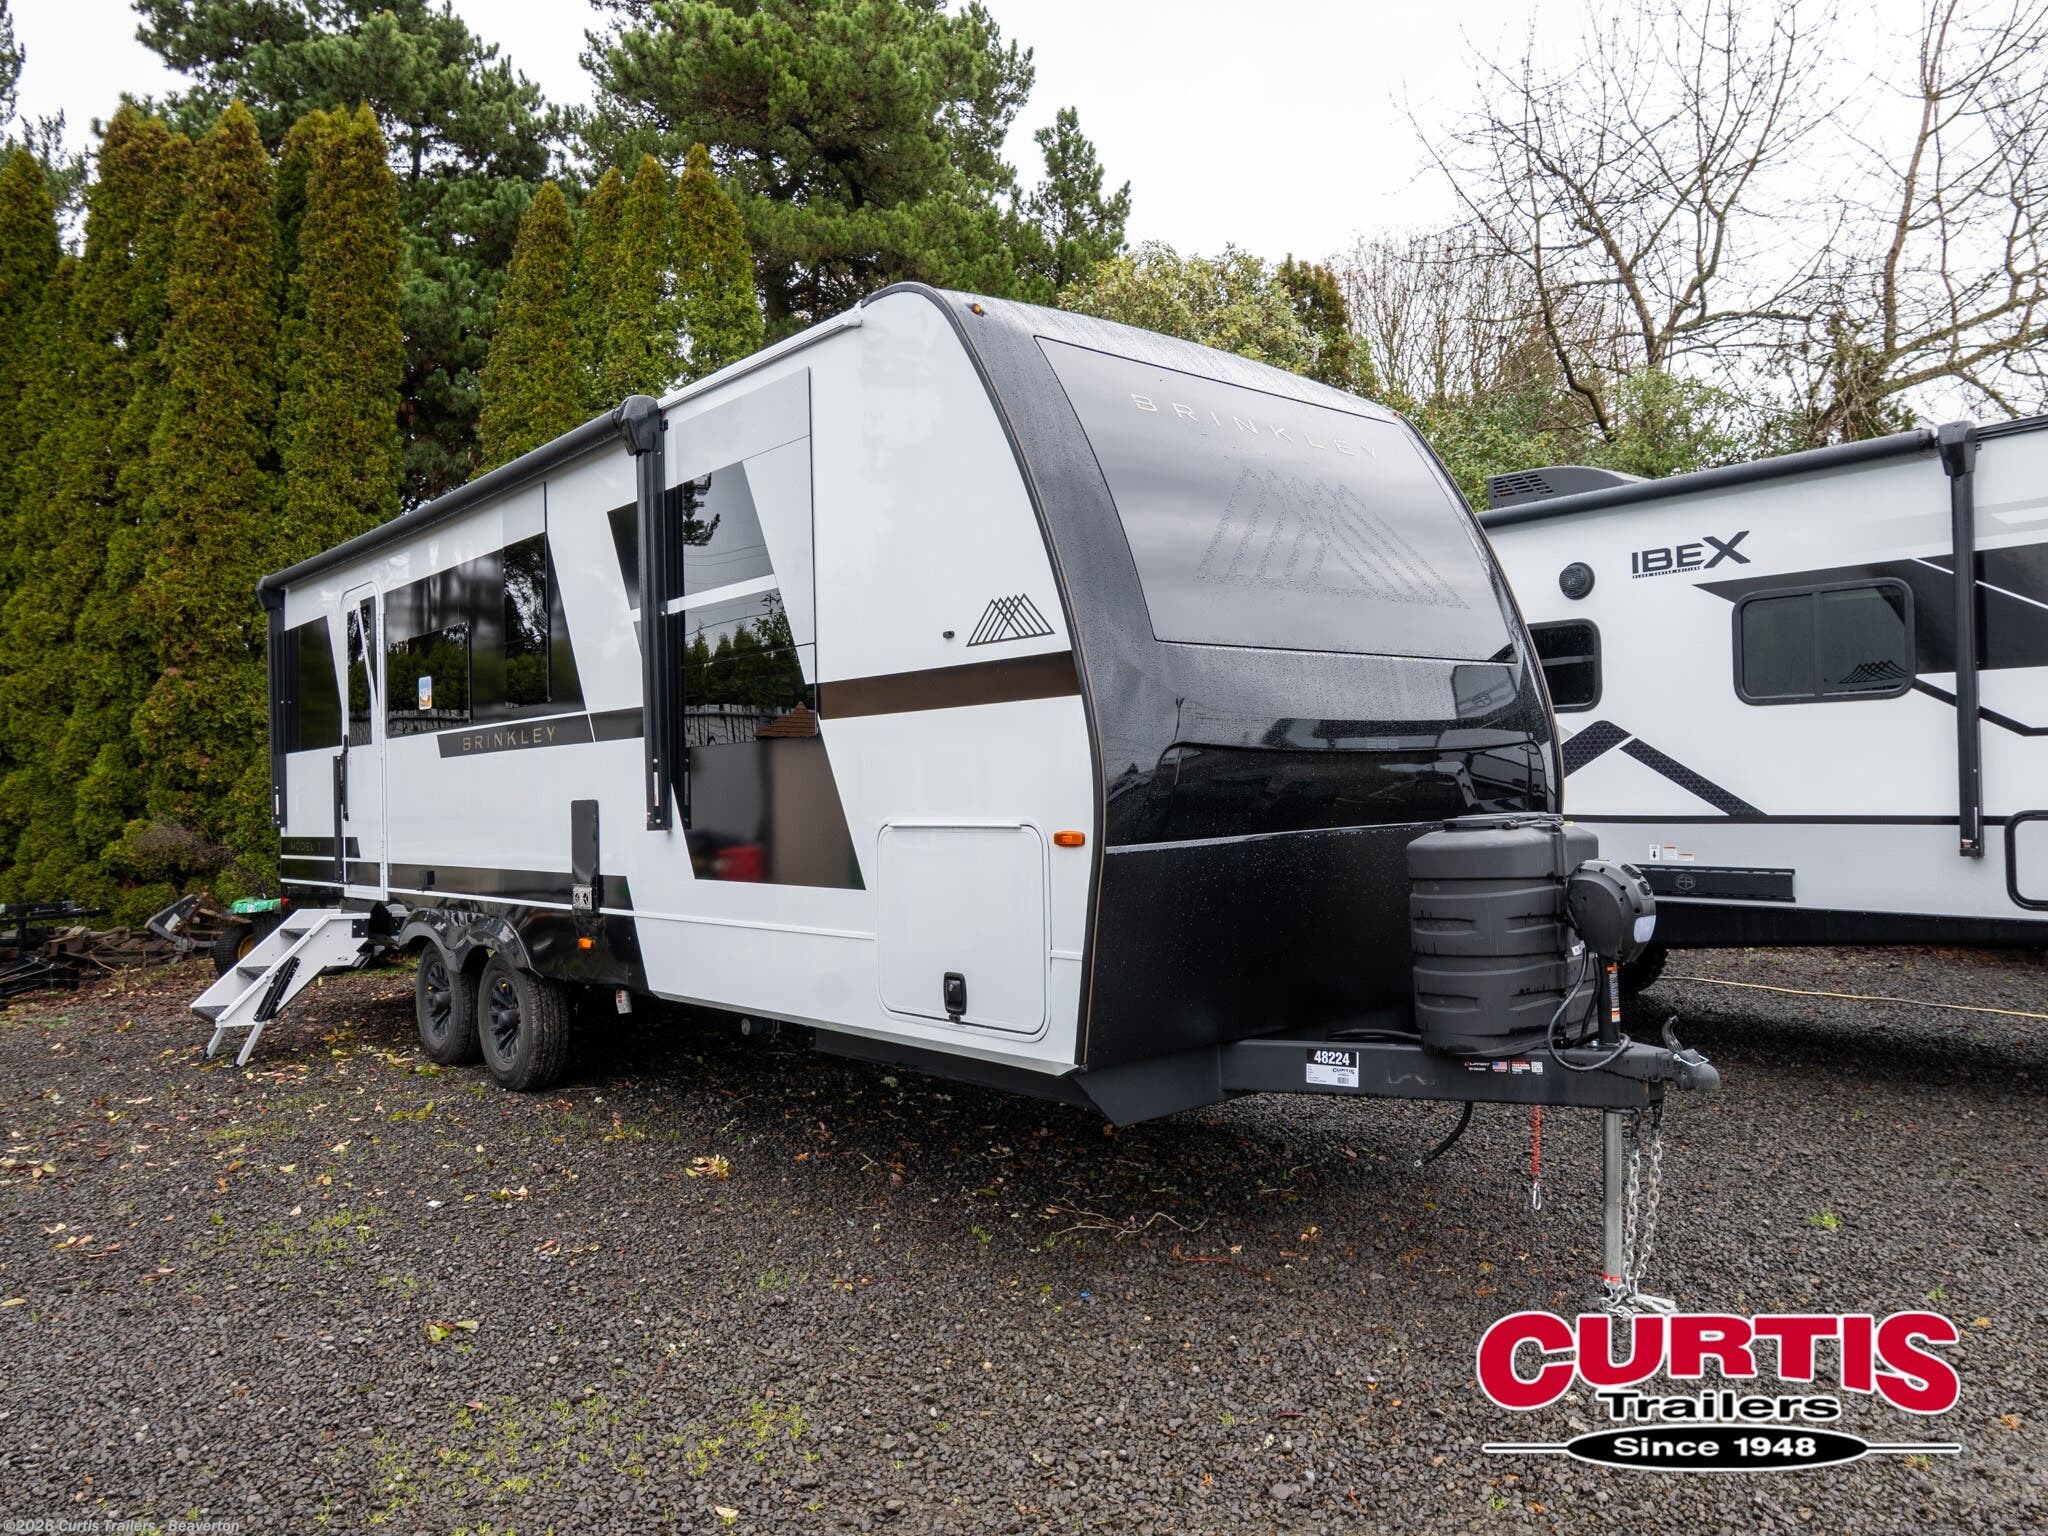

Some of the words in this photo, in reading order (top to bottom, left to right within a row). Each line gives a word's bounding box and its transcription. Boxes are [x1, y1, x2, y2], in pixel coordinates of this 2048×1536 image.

[1130, 393, 1377, 464] BRINKLEY
[1631, 530, 1751, 574] IBEX
[463, 726, 555, 751] BRINKLEY
[1314, 1050, 1350, 1066] 48224
